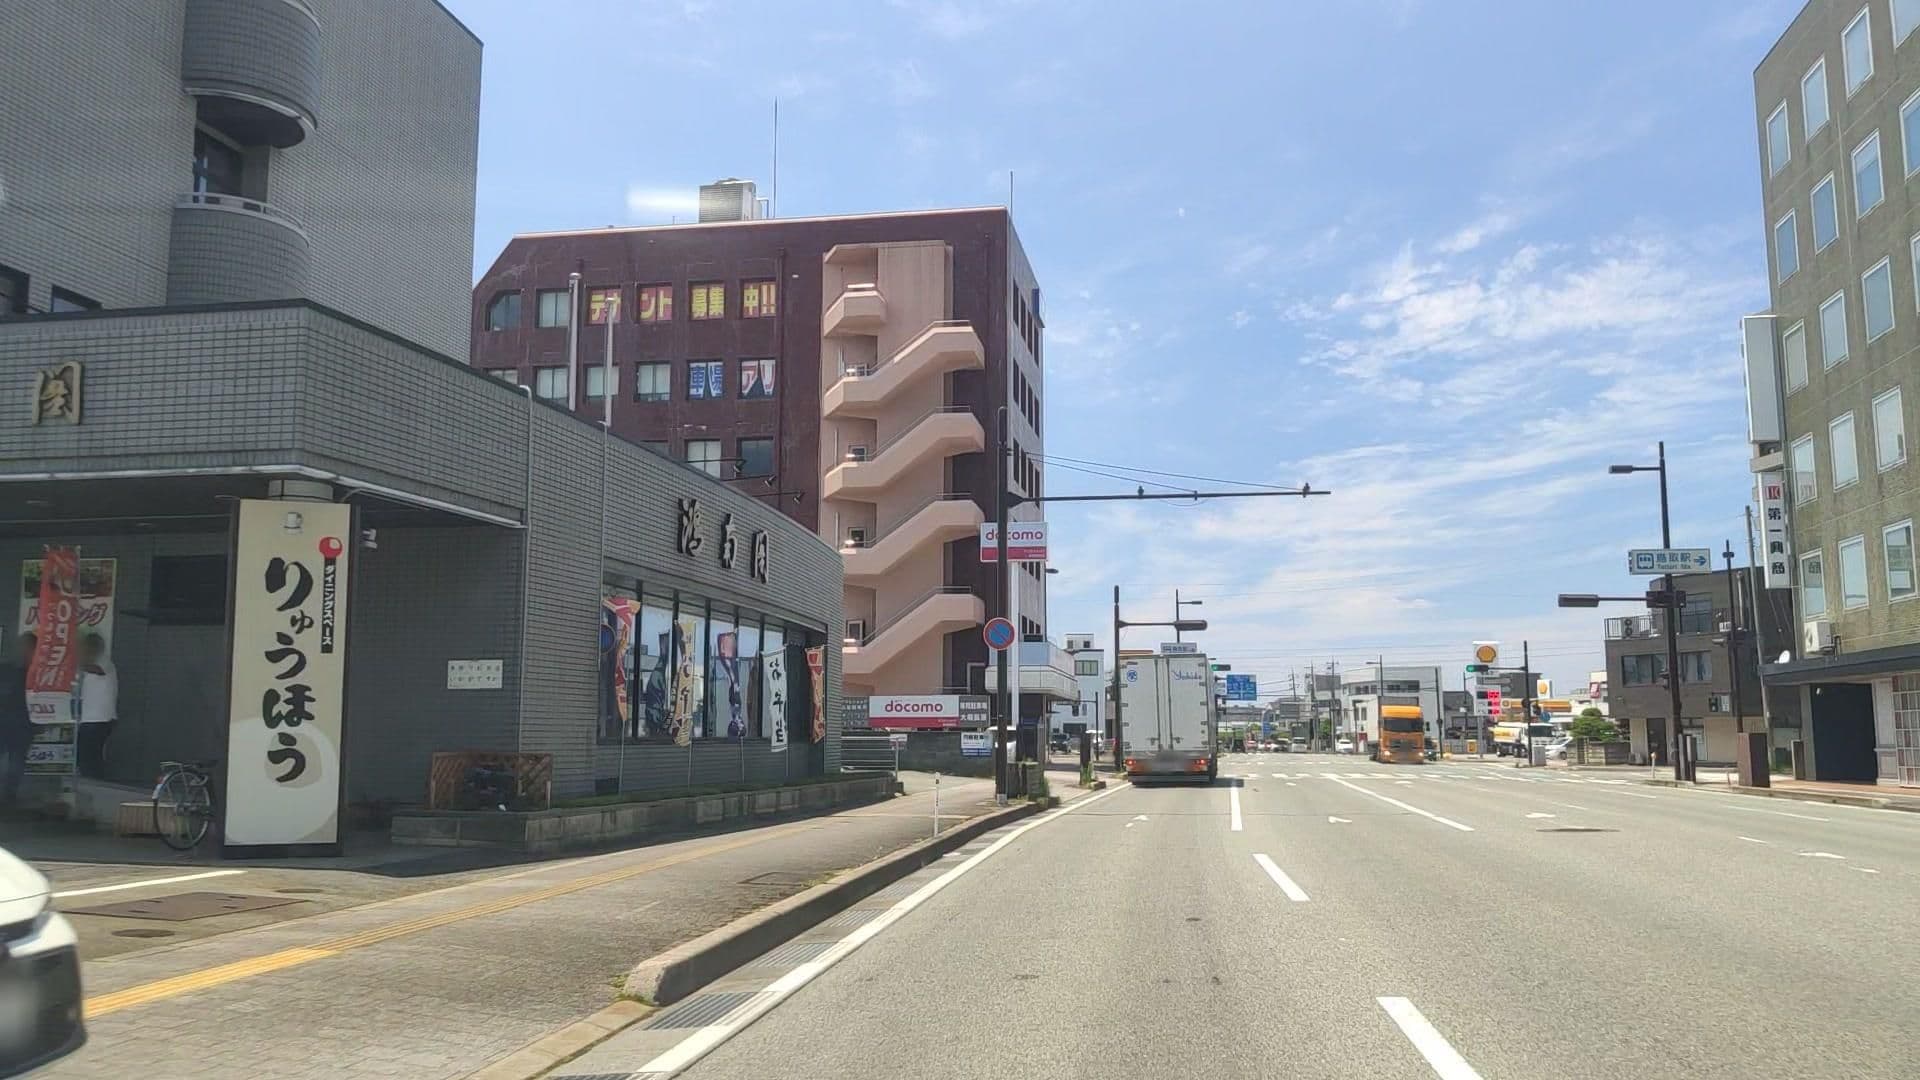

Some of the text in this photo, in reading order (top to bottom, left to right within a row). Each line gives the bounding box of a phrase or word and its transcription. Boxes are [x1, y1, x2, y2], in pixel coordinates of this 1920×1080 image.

[1656, 552, 1692, 563] 鳥取駅
[322, 565, 337, 646] ダイニングスペース
[262, 556, 316, 783] りゅうほう
[884, 701, 944, 713] docomo
